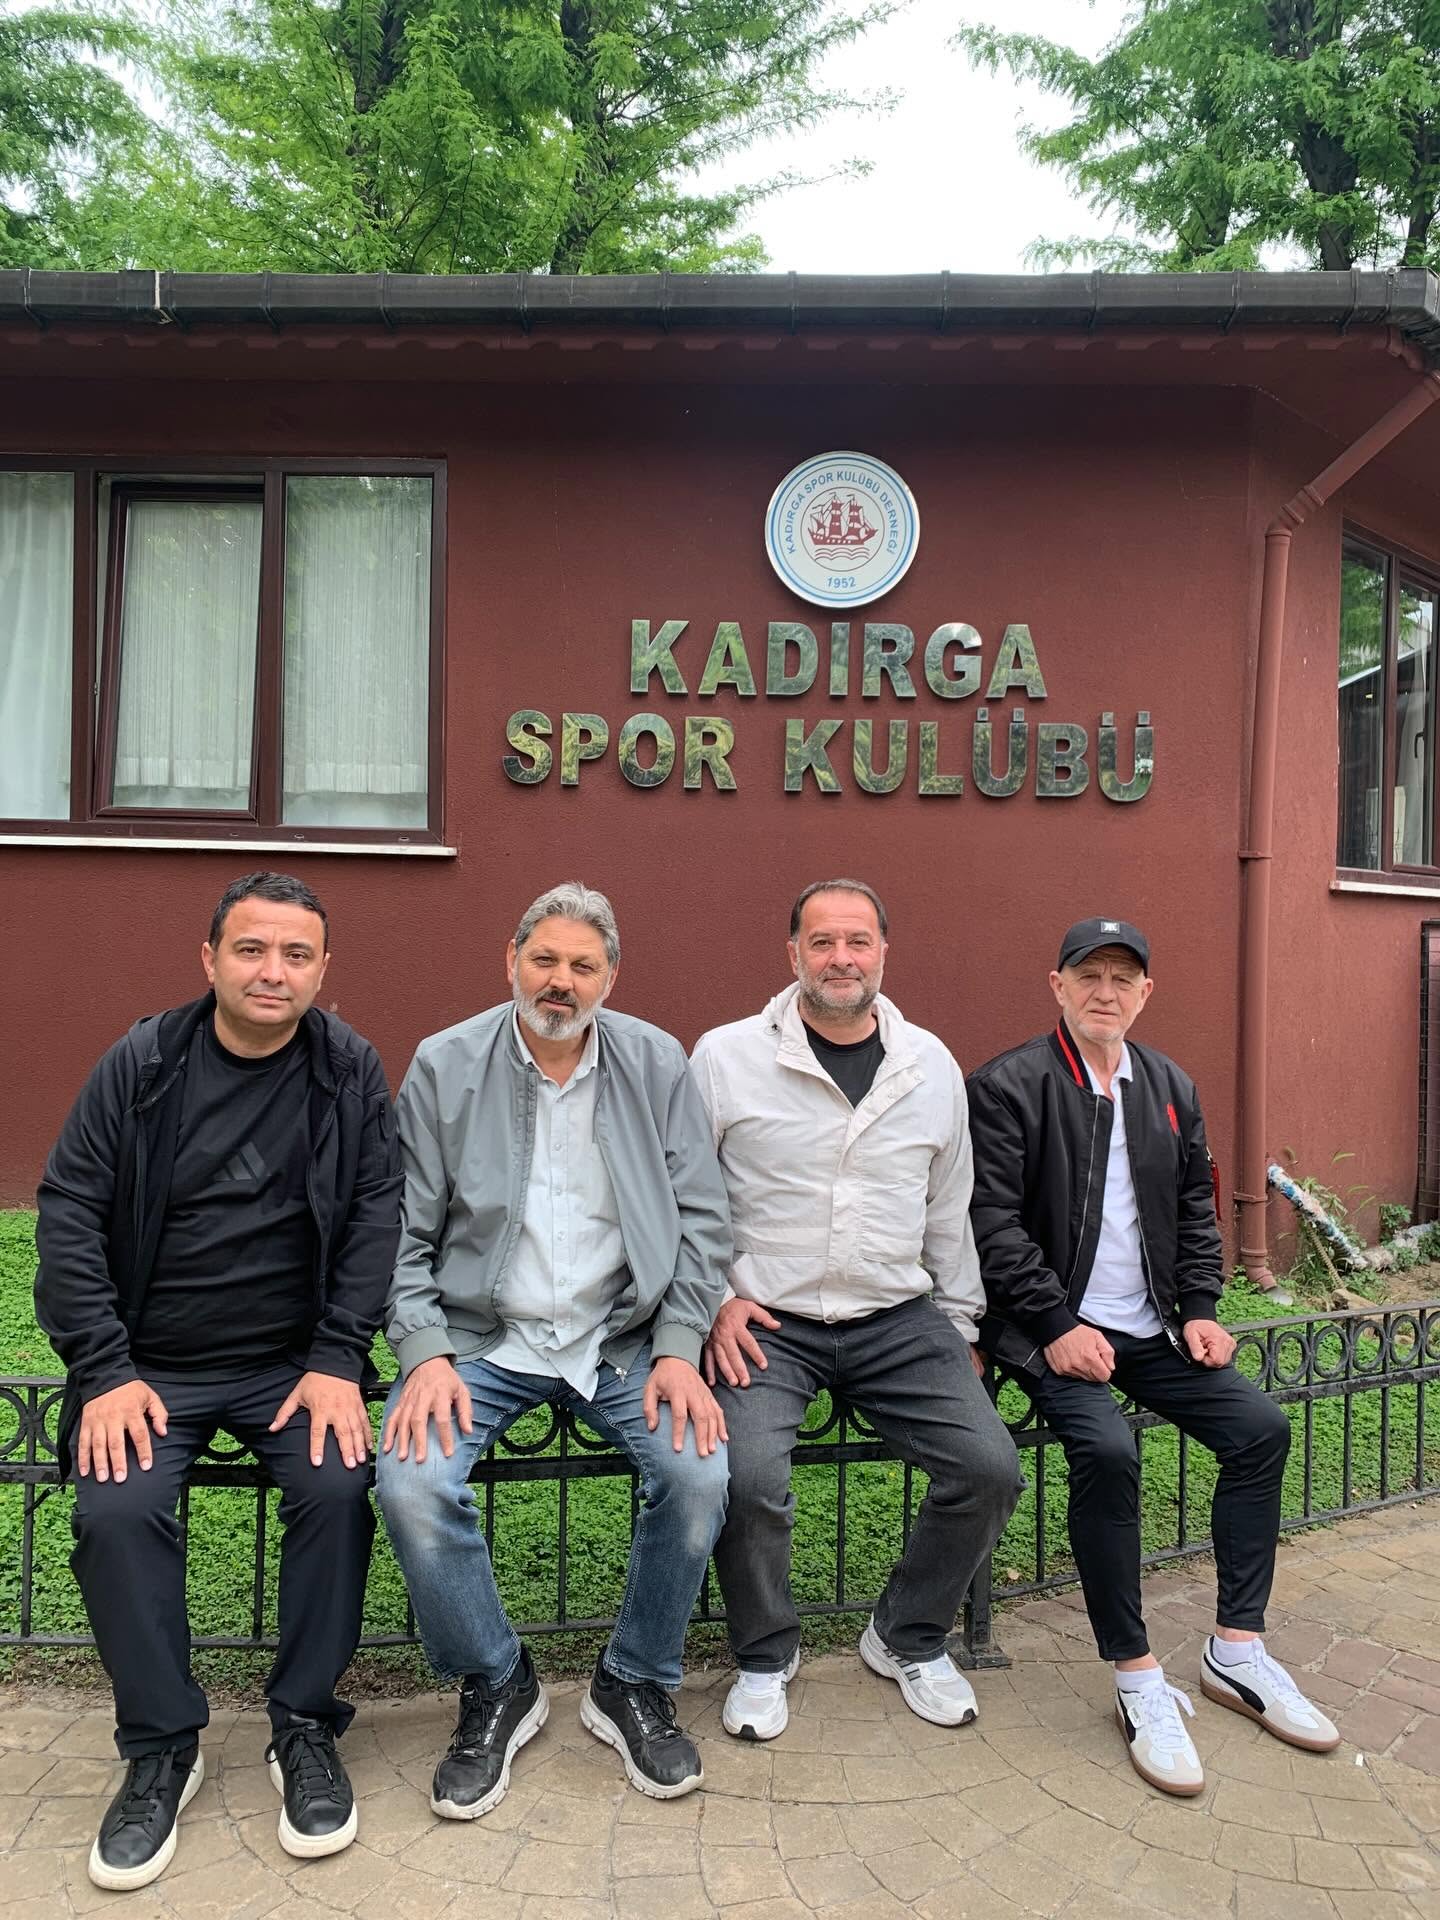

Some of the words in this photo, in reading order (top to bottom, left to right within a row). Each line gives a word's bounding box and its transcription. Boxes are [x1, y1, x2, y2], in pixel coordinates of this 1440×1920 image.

[784, 493, 805, 554] KADIRGA
[804, 472, 834, 494] SPOR
[837, 471, 881, 494] KULÜBÜ
[827, 576, 857, 589] 1952
[630, 619, 1048, 699] KADIRGA
[502, 709, 738, 791] SPOR
[784, 708, 1154, 803] KULÜBÜ
